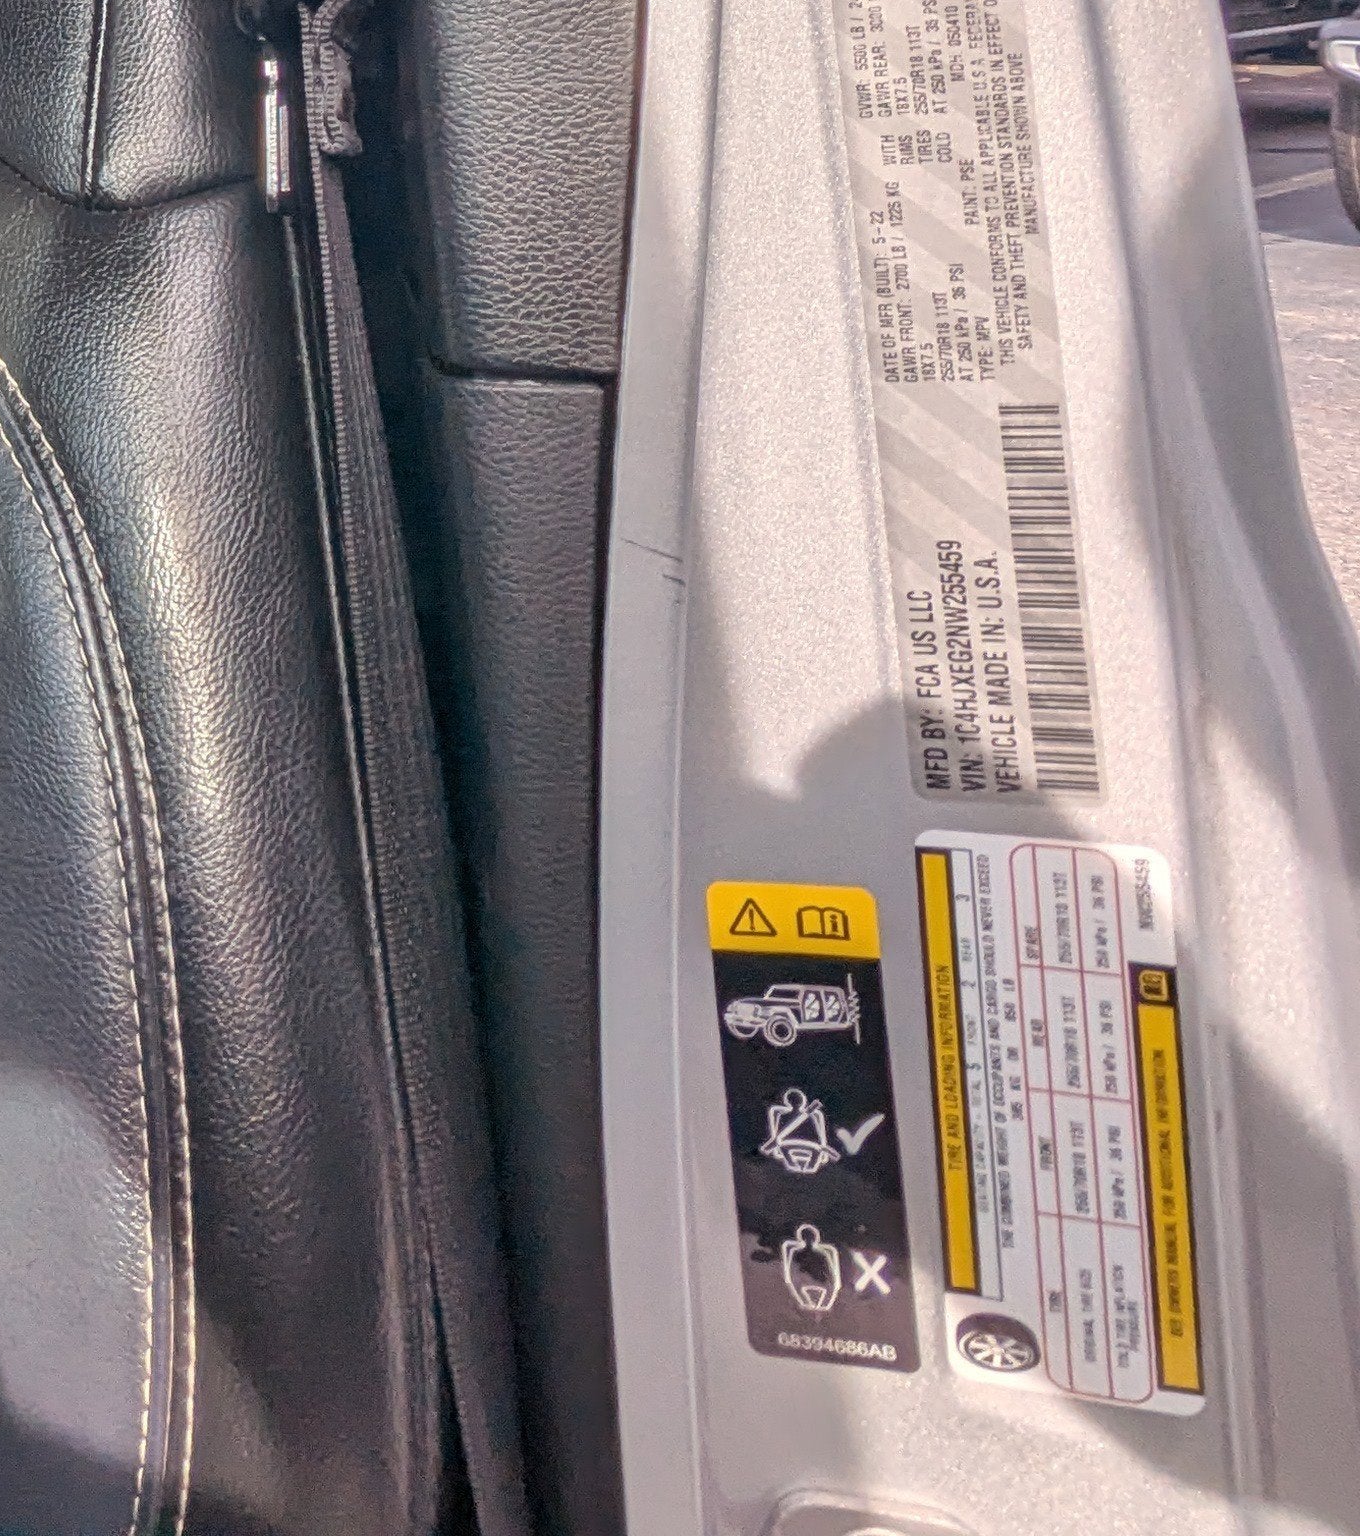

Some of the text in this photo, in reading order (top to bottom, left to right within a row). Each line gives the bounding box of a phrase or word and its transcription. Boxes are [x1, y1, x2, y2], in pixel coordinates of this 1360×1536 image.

[849, 26, 866, 39] LB
[905, 24, 922, 50] 113T
[983, 11, 1003, 54] EFFECT
[851, 44, 869, 70] 5500
[988, 59, 1005, 71] IN
[929, 74, 946, 93] 250
[874, 81, 892, 117] GAWR
[932, 99, 948, 113] AT
[989, 76, 1013, 148] STANDARDS
[972, 94, 995, 165] APPLICABLE
[1010, 95, 1031, 140] SHOWN
[880, 134, 897, 165] WITH
[897, 134, 915, 164] RIMS
[915, 129, 933, 163] TIRES
[934, 132, 952, 163] COLD
[958, 158, 975, 181] PSE
[980, 171, 998, 191] ALL
[884, 181, 901, 196] KG
[983, 196, 1000, 211] TO
[997, 153, 1021, 227] PREVENTION
[1016, 144, 1040, 233] MANUFACTURE
[891, 245, 907, 258] LB
[985, 216, 1007, 281] CONFORMS
[1005, 232, 1025, 269] THEFT
[892, 263, 910, 289] 2700
[948, 263, 964, 281] PSI
[1010, 274, 1028, 298] AND
[877, 303, 895, 327] MFR
[992, 285, 1013, 334] VEHICLE
[880, 333, 897, 347] OF
[1013, 304, 1034, 349] SAFETY
[955, 341, 972, 361] 250
[973, 316, 995, 380] TYPE: MPV
[997, 337, 1016, 365] THIS
[882, 352, 900, 382] DATE
[900, 346, 919, 382] GAWR
[958, 366, 974, 381] AT
[936, 540, 986, 791] VIN: 1C4HJXEG2NW255459
[971, 550, 1021, 793] VEHICLE MADE IN: U.S.A.
[907, 590, 951, 789] MFD BY: FCA US LLC
[935, 964, 962, 1171] TIRE AND LOADING INFORMATION
